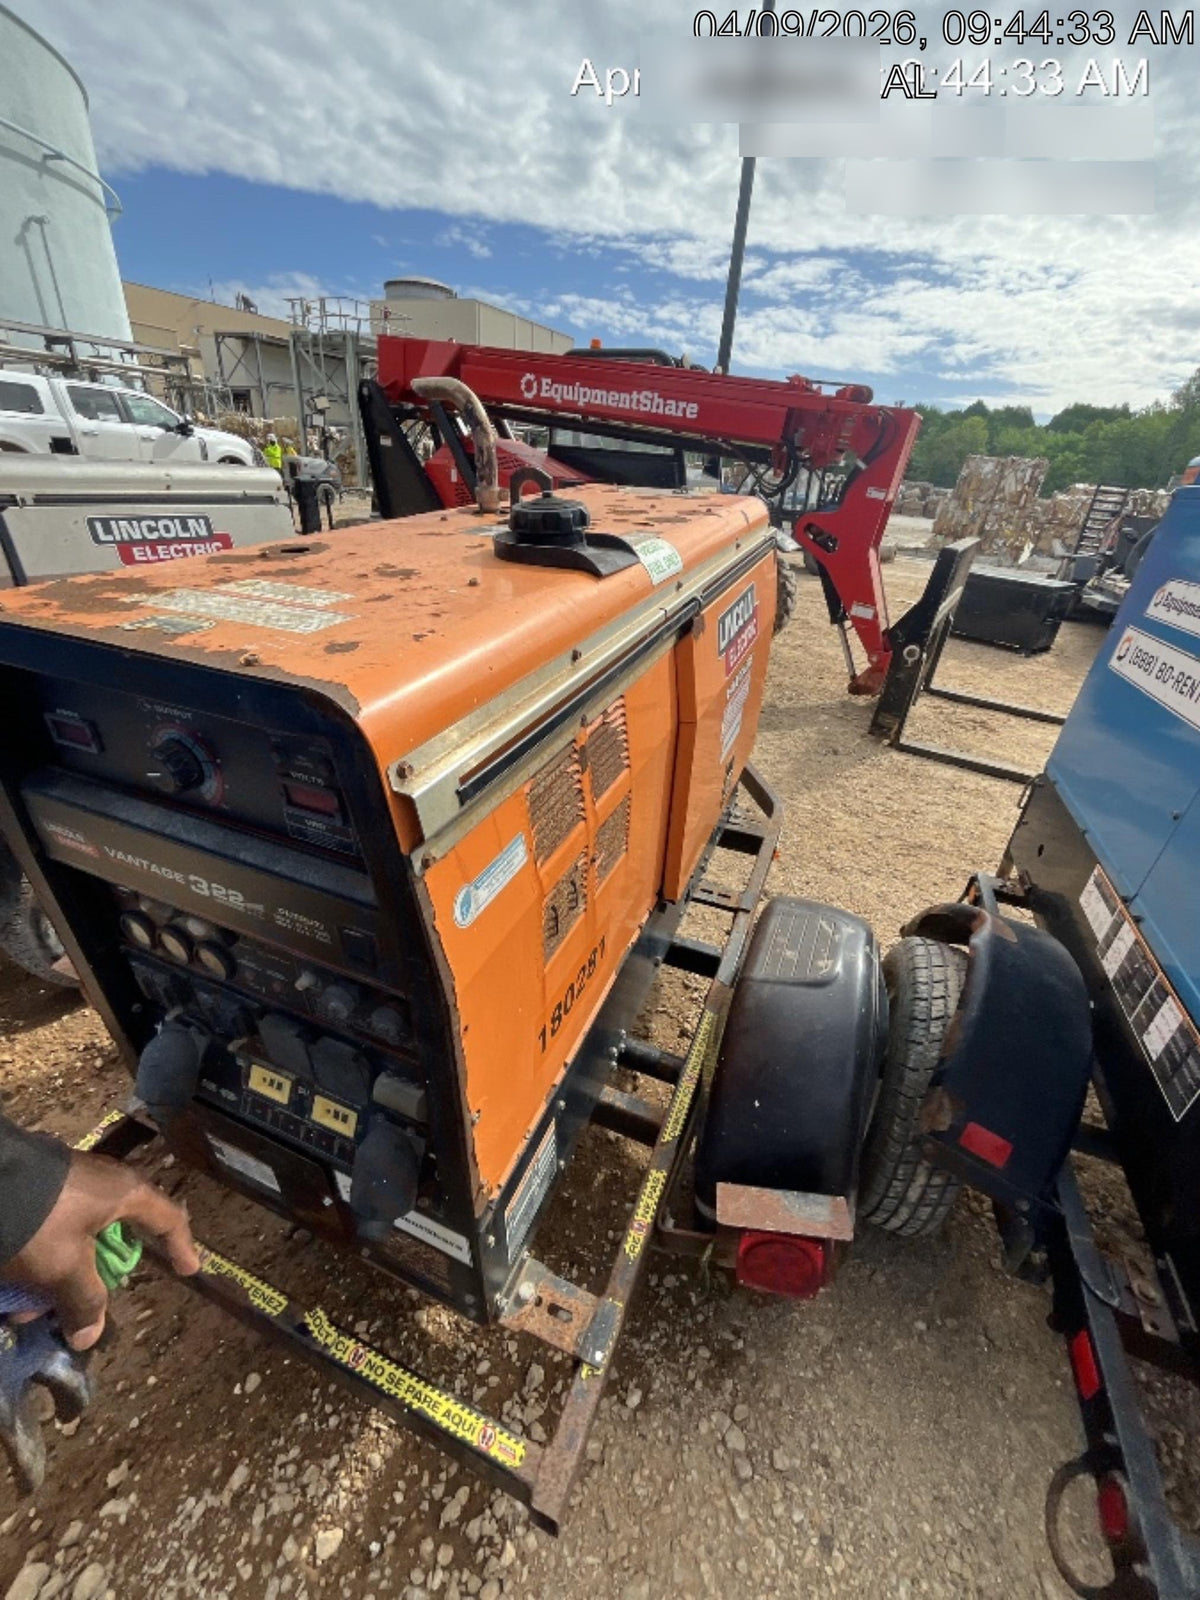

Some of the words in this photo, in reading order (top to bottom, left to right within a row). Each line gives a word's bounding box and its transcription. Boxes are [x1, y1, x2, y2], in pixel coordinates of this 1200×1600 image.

[540, 377, 699, 419] EquipmentShare
[93, 518, 209, 542] LINCOLN
[103, 845, 187, 885] VANTAGE
[190, 873, 245, 904] 322
[537, 934, 606, 1054] 180281
[363, 1358, 385, 1378] NO
[385, 1371, 407, 1391] SE
[404, 1383, 442, 1414] PARE
